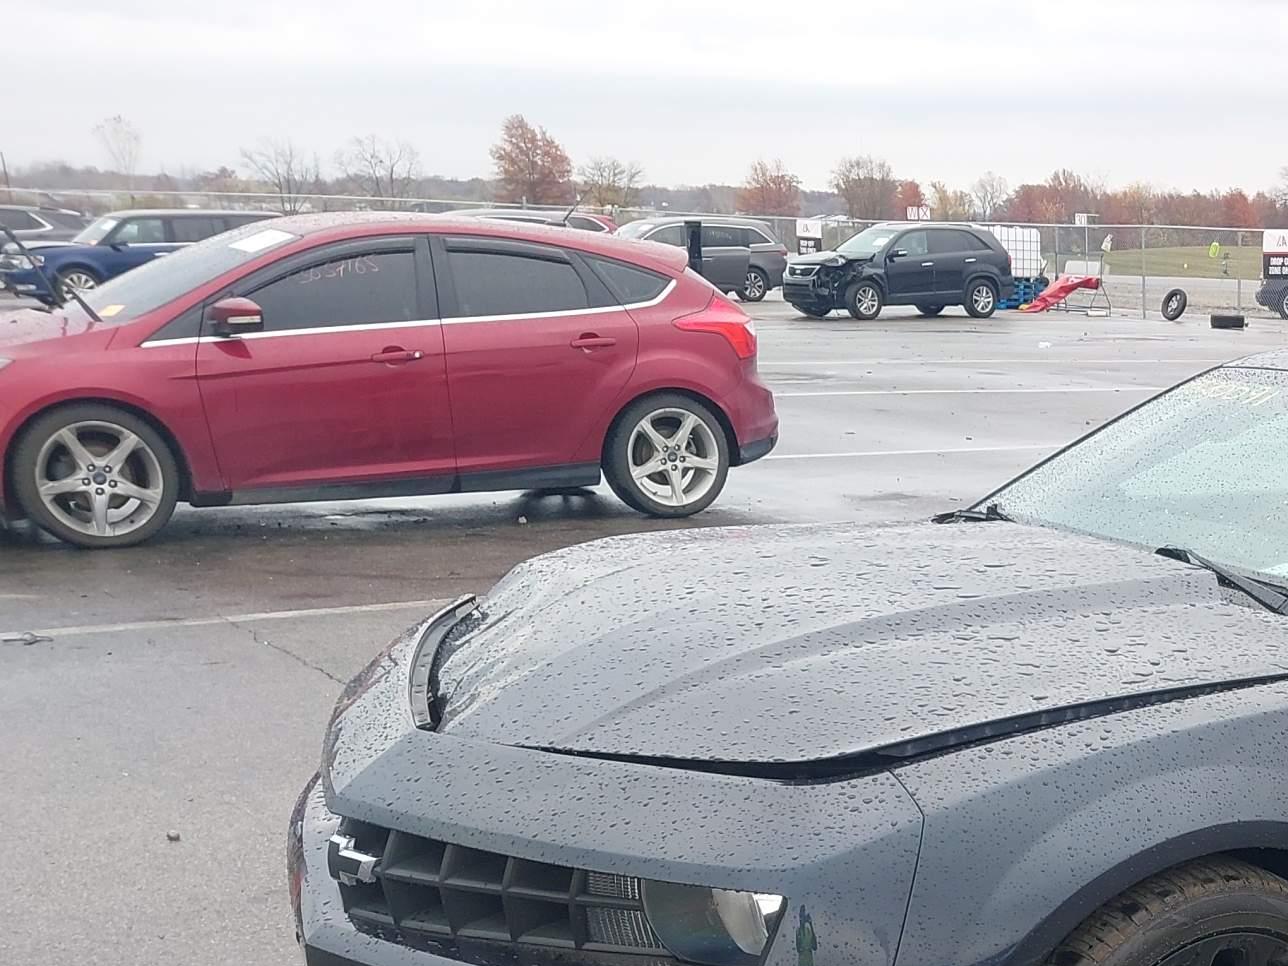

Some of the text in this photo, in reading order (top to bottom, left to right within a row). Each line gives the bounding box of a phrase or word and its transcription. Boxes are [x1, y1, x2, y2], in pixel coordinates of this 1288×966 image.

[908, 207, 917, 219] W
[920, 207, 929, 219] X
[1270, 257, 1283, 266] DROP
